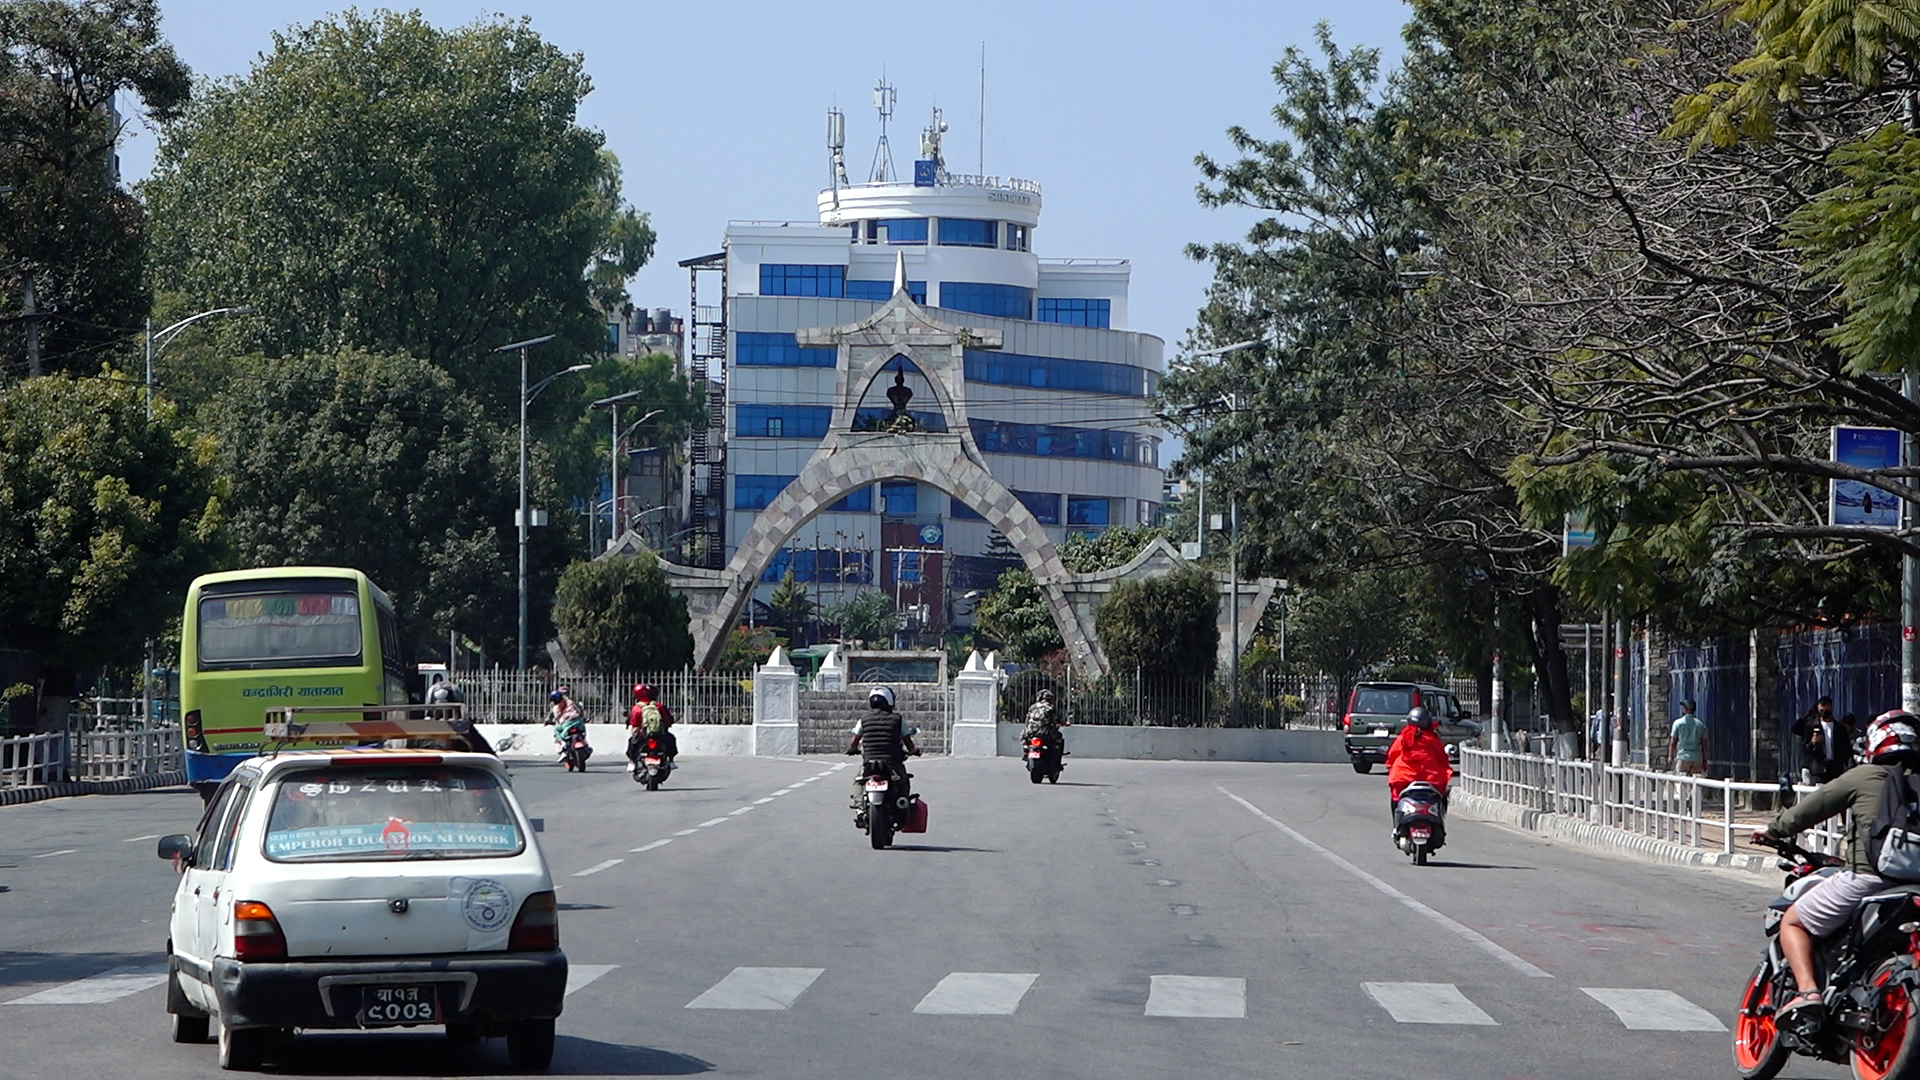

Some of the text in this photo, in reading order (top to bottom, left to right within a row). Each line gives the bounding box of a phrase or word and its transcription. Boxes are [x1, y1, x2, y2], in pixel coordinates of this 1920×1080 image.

[297, 686, 344, 697] यातायात
[269, 838, 343, 853] EMPEROR
[437, 834, 510, 845] NETWORK
